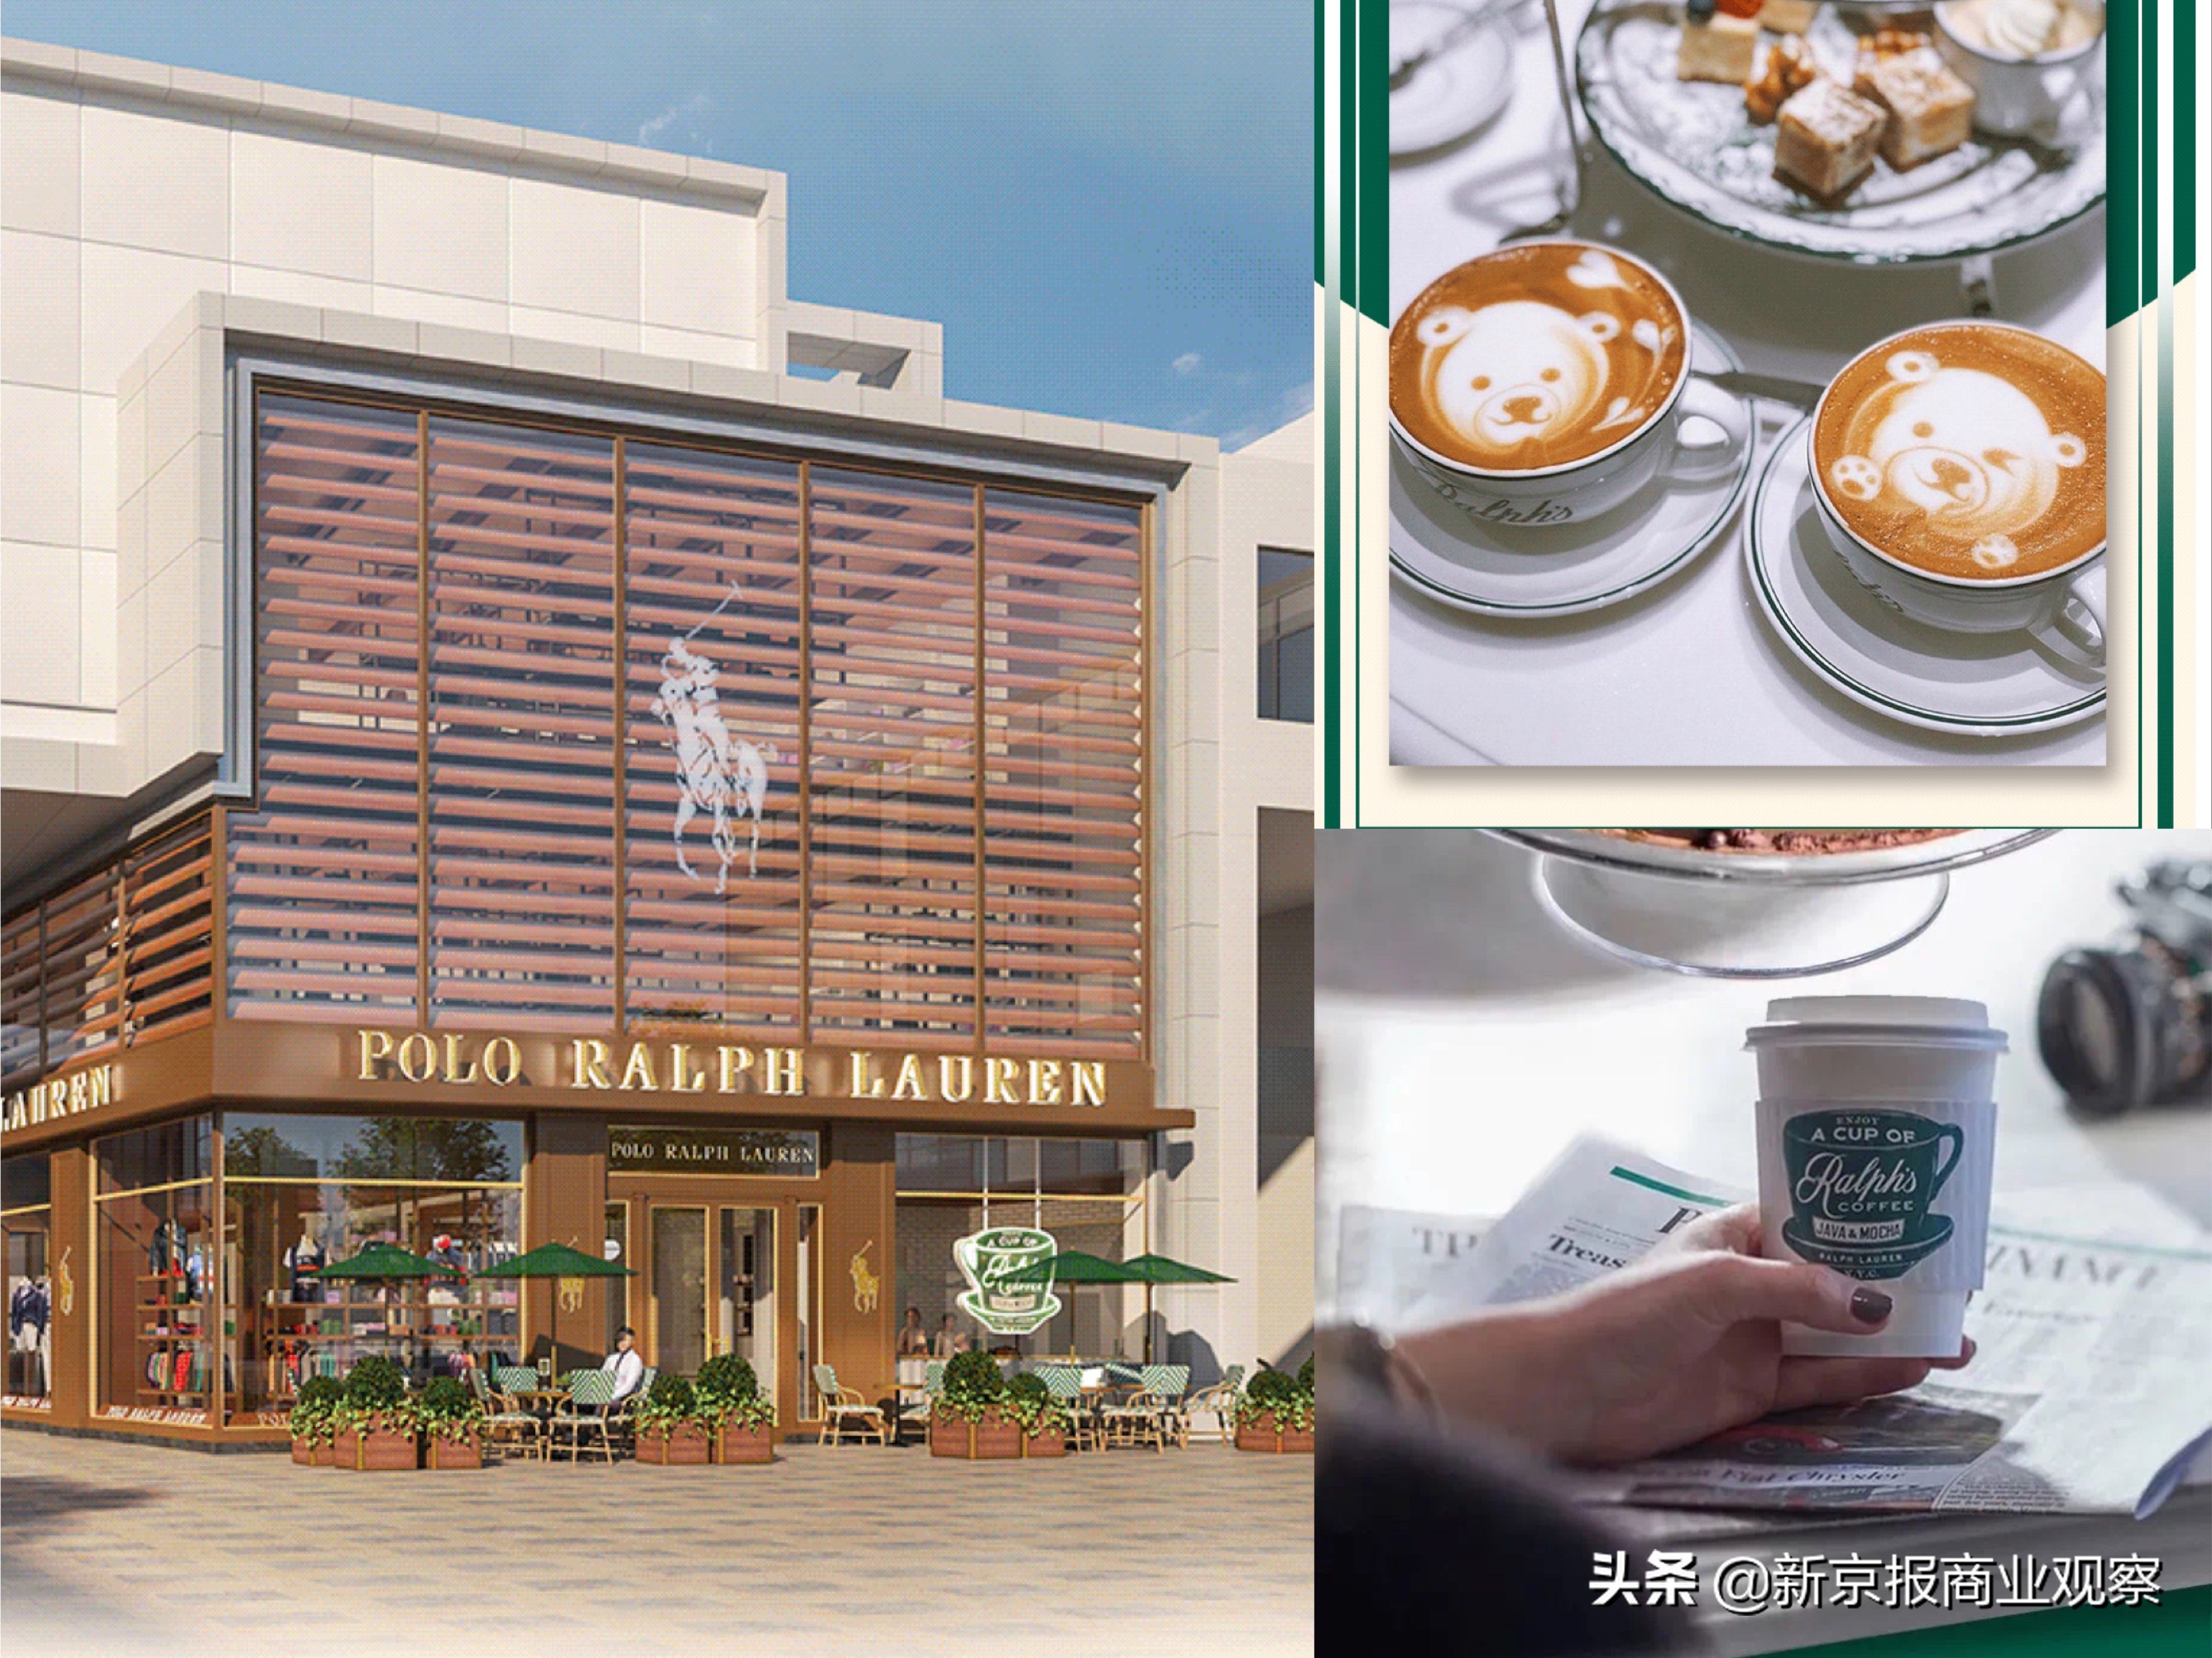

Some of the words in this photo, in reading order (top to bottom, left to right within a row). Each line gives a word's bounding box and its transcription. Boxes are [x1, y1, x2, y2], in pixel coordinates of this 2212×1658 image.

[358, 1030, 522, 1086] POLO
[572, 1039, 805, 1096] RALPH
[850, 1051, 1108, 1107] LAUREN
[1837, 1116, 1880, 1125] ENJOY
[1812, 1127, 1826, 1142] A
[1833, 1127, 1879, 1141] CUP
[1886, 1129, 1916, 1143] OF
[611, 1141, 654, 1159] POLO
[665, 1143, 729, 1161] RALPH
[742, 1146, 814, 1164] LAUREN
[1796, 1152, 1917, 1219] Ralph's
[1838, 1200, 1914, 1213] COFFEE
[1815, 1222, 1846, 1239] JAVA
[1848, 1229, 1856, 1238] &
[1859, 1223, 1901, 1240] MOCHA
[1819, 1251, 1854, 1262] RALPH
[1859, 1253, 1903, 1264] LAUREN
